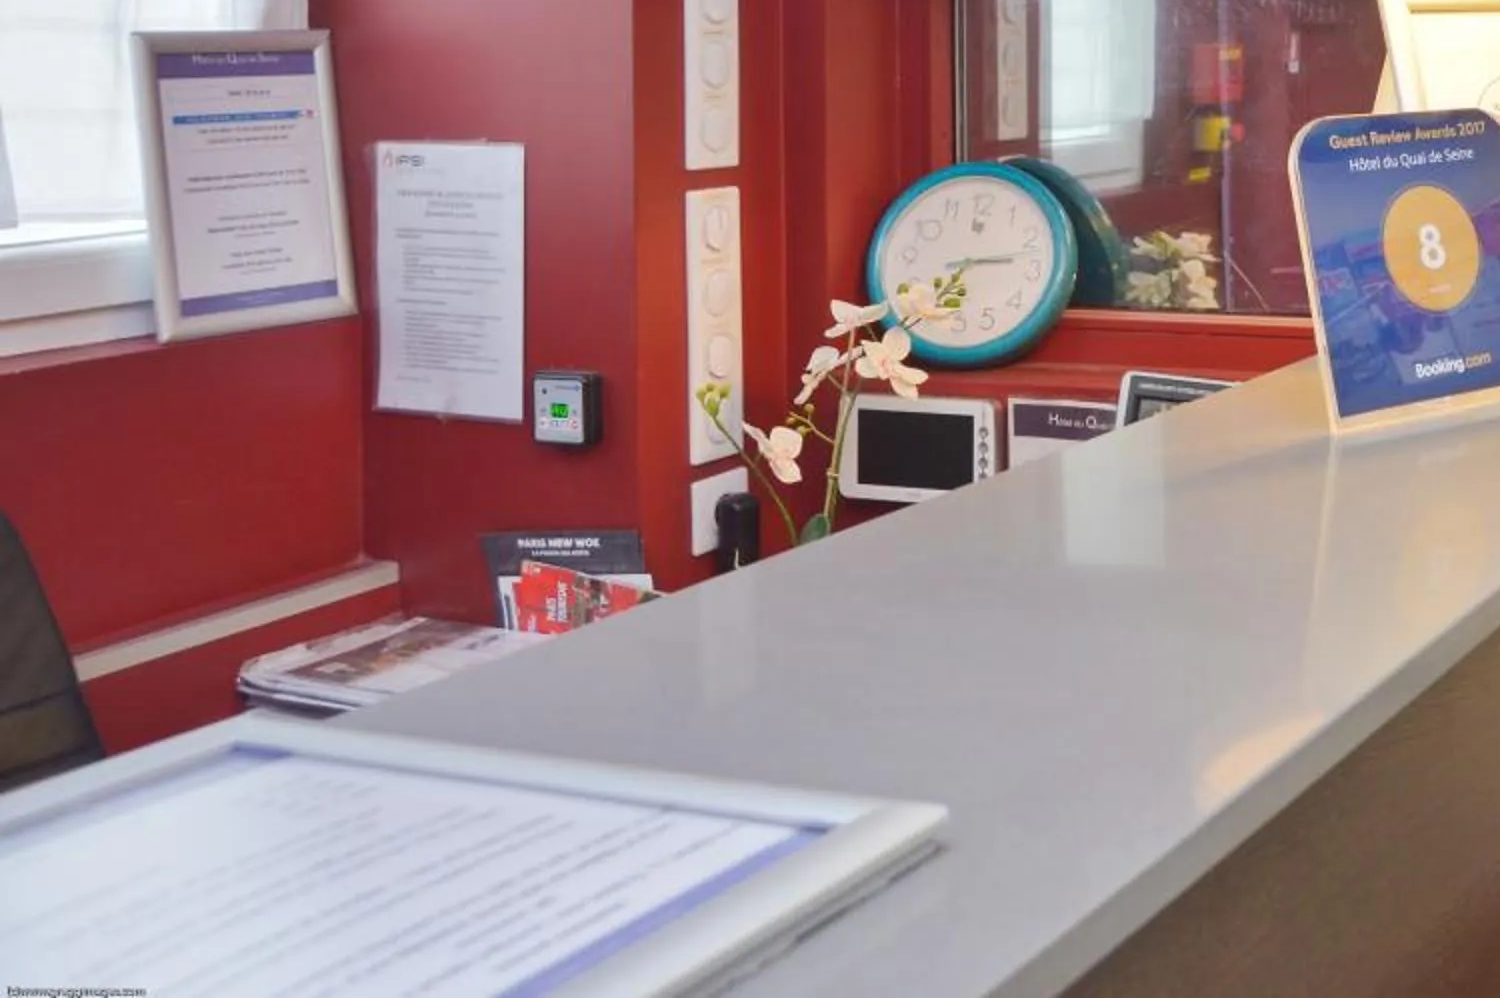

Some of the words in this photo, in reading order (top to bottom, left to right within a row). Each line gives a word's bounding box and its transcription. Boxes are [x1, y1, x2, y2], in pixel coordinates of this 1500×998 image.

[1329, 131, 1368, 150] Guest
[1370, 128, 1411, 147] Review
[1415, 123, 1456, 142] Awards
[1458, 120, 1485, 137] 2017
[1349, 154, 1381, 172] Hôtel
[1383, 154, 1399, 169] du
[1400, 152, 1427, 169] Quai
[1429, 149, 1443, 163] de
[1445, 147, 1474, 161] Seine
[1419, 222, 1446, 270] 8
[978, 307, 995, 331] 5
[1415, 352, 1492, 379] Booking.com
